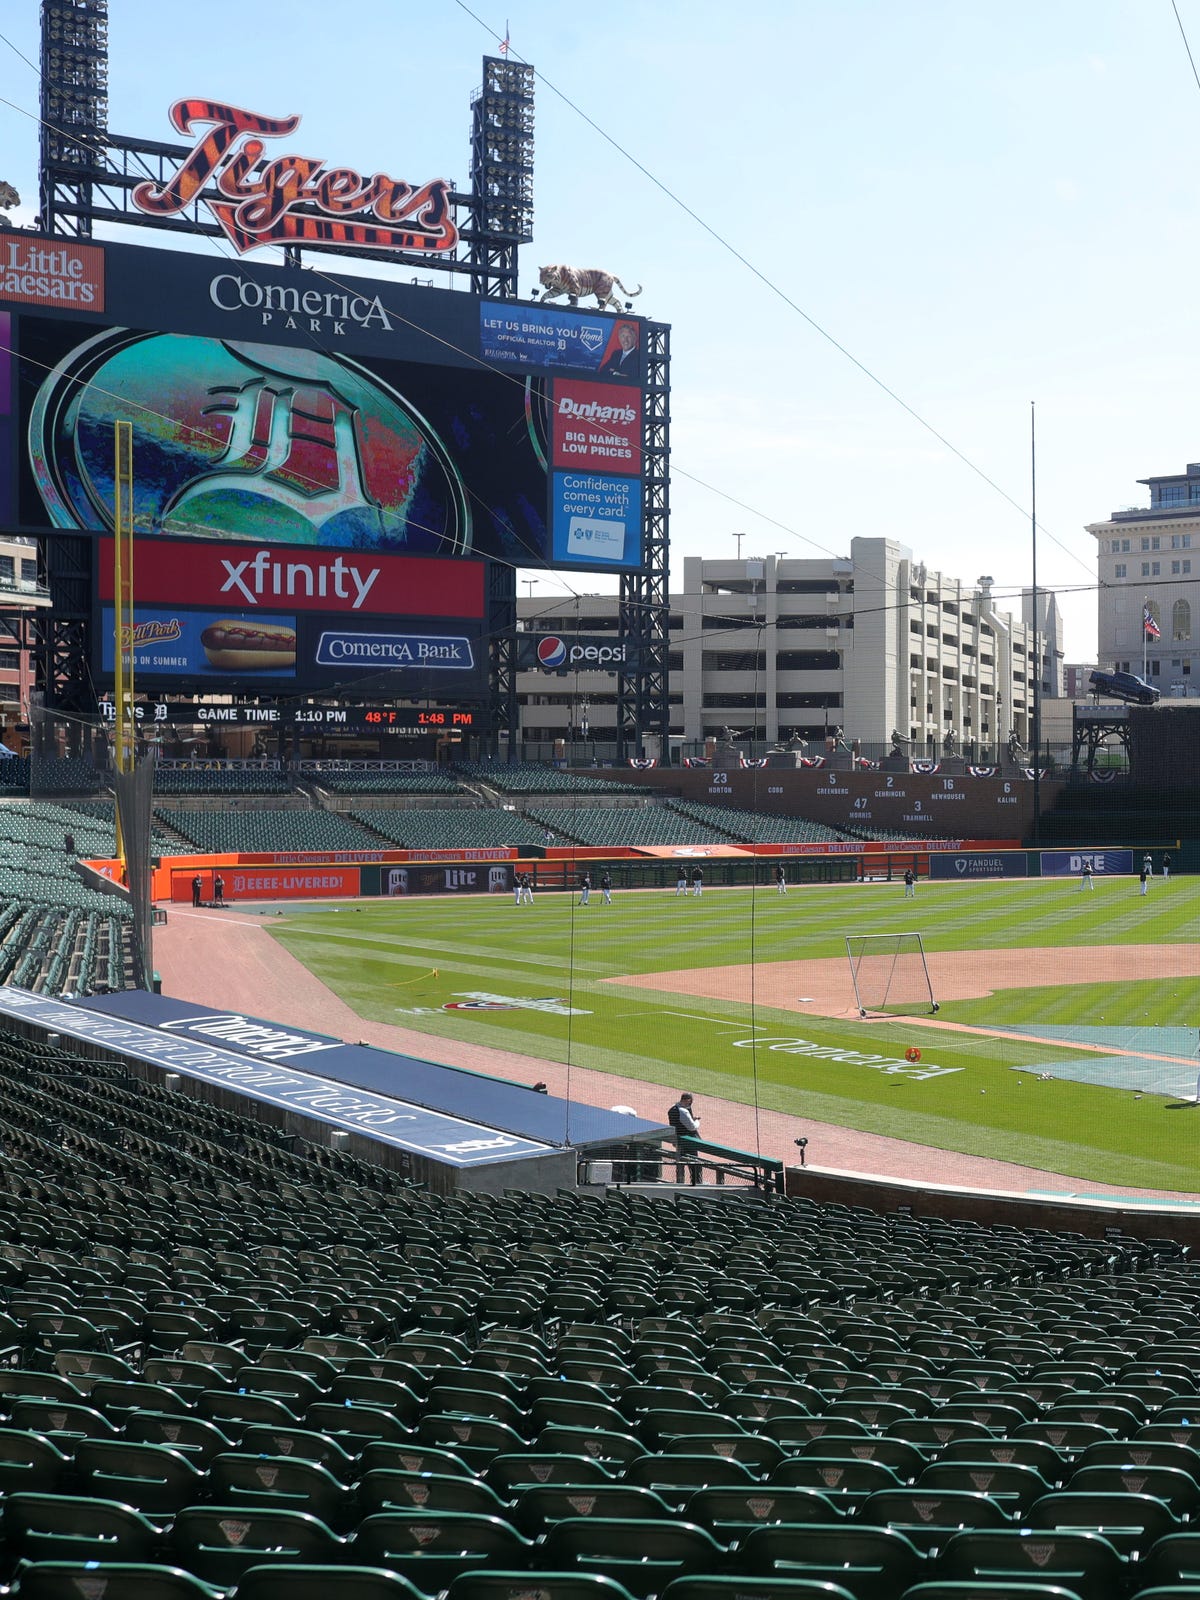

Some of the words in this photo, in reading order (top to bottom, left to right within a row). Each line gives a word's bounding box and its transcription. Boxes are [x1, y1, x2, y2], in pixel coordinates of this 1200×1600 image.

[132, 97, 459, 256] Tigers
[7, 241, 84, 279] Little
[262, 312, 346, 335] PARK
[484, 318, 502, 328] LET
[506, 321, 519, 331] US
[522, 323, 554, 335] BRING
[557, 328, 578, 339] YOU
[497, 334, 526, 345] OFFICIAL
[527, 337, 555, 347] REALTOR
[558, 397, 637, 422] Dunham's
[565, 431, 585, 443] BIG
[589, 434, 629, 447] NAMES
[562, 443, 588, 454] LOW
[590, 446, 632, 459] PRICES
[563, 475, 629, 493] Confidence
[563, 491, 601, 504] comes
[604, 493, 629, 505] with
[563, 502, 595, 517] every
[598, 503, 626, 517] card.
[220, 551, 381, 609] xfinity
[146, 618, 181, 642] Park
[417, 642, 462, 660] Bank
[569, 644, 627, 665] pepsi
[140, 656, 151, 665] ON
[153, 656, 188, 667] SUMMER
[197, 708, 238, 721] GAME
[244, 708, 281, 721] TIME:
[294, 710, 323, 722] 1:10
[326, 710, 347, 722] PM
[418, 712, 445, 724] 1:48
[452, 713, 472, 725] PM
[713, 773, 728, 784] 23
[829, 774, 836, 785] 5
[886, 776, 894, 788] 2
[943, 779, 954, 790] 16
[1004, 782, 1011, 794] 6
[854, 798, 868, 809] 47
[914, 801, 922, 812] 3
[828, 844, 865, 853] DELIVERY
[926, 842, 961, 850] DELIVERY
[273, 855, 297, 863] Little
[297, 854, 330, 863] Caesars
[334, 853, 384, 863] DELIVERY
[408, 852, 429, 861] Little
[430, 851, 461, 861] Caesars
[464, 850, 511, 860] DELIVERY
[968, 859, 1003, 867] FANDUEL
[1069, 855, 1105, 872] DTE
[444, 869, 477, 889] Lite
[36, 1011, 115, 1031] HOME
[92, 1029, 145, 1039] OF
[121, 1037, 189, 1054] THE
[165, 1051, 304, 1088] DETROIT
[280, 1085, 417, 1125] TIGERS
